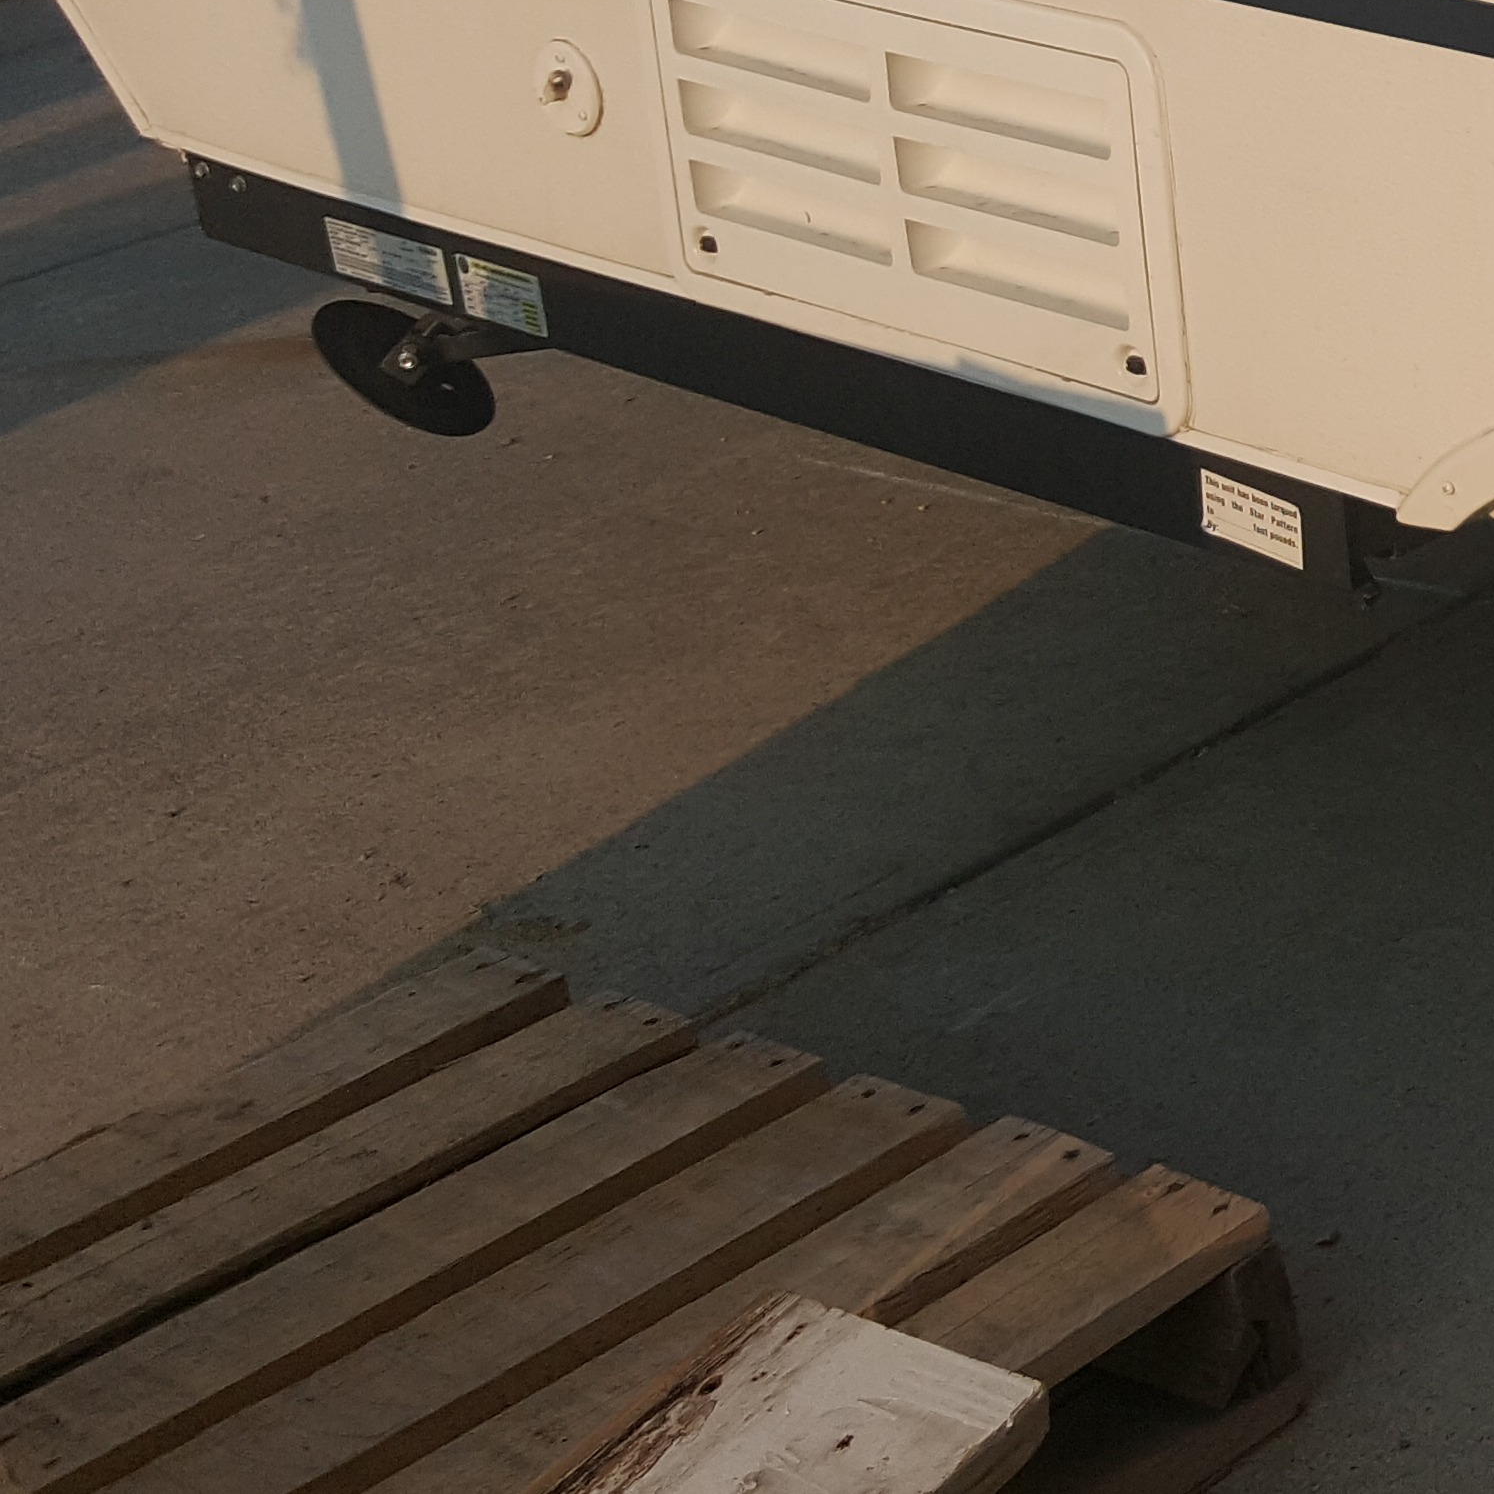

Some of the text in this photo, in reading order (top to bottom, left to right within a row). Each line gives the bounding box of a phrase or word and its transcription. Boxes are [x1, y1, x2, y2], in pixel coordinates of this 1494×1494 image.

[1205, 475, 1219, 488] This
[1237, 488, 1249, 500] has
[1252, 493, 1268, 507] been
[1206, 492, 1298, 534] using the Star Pattern
